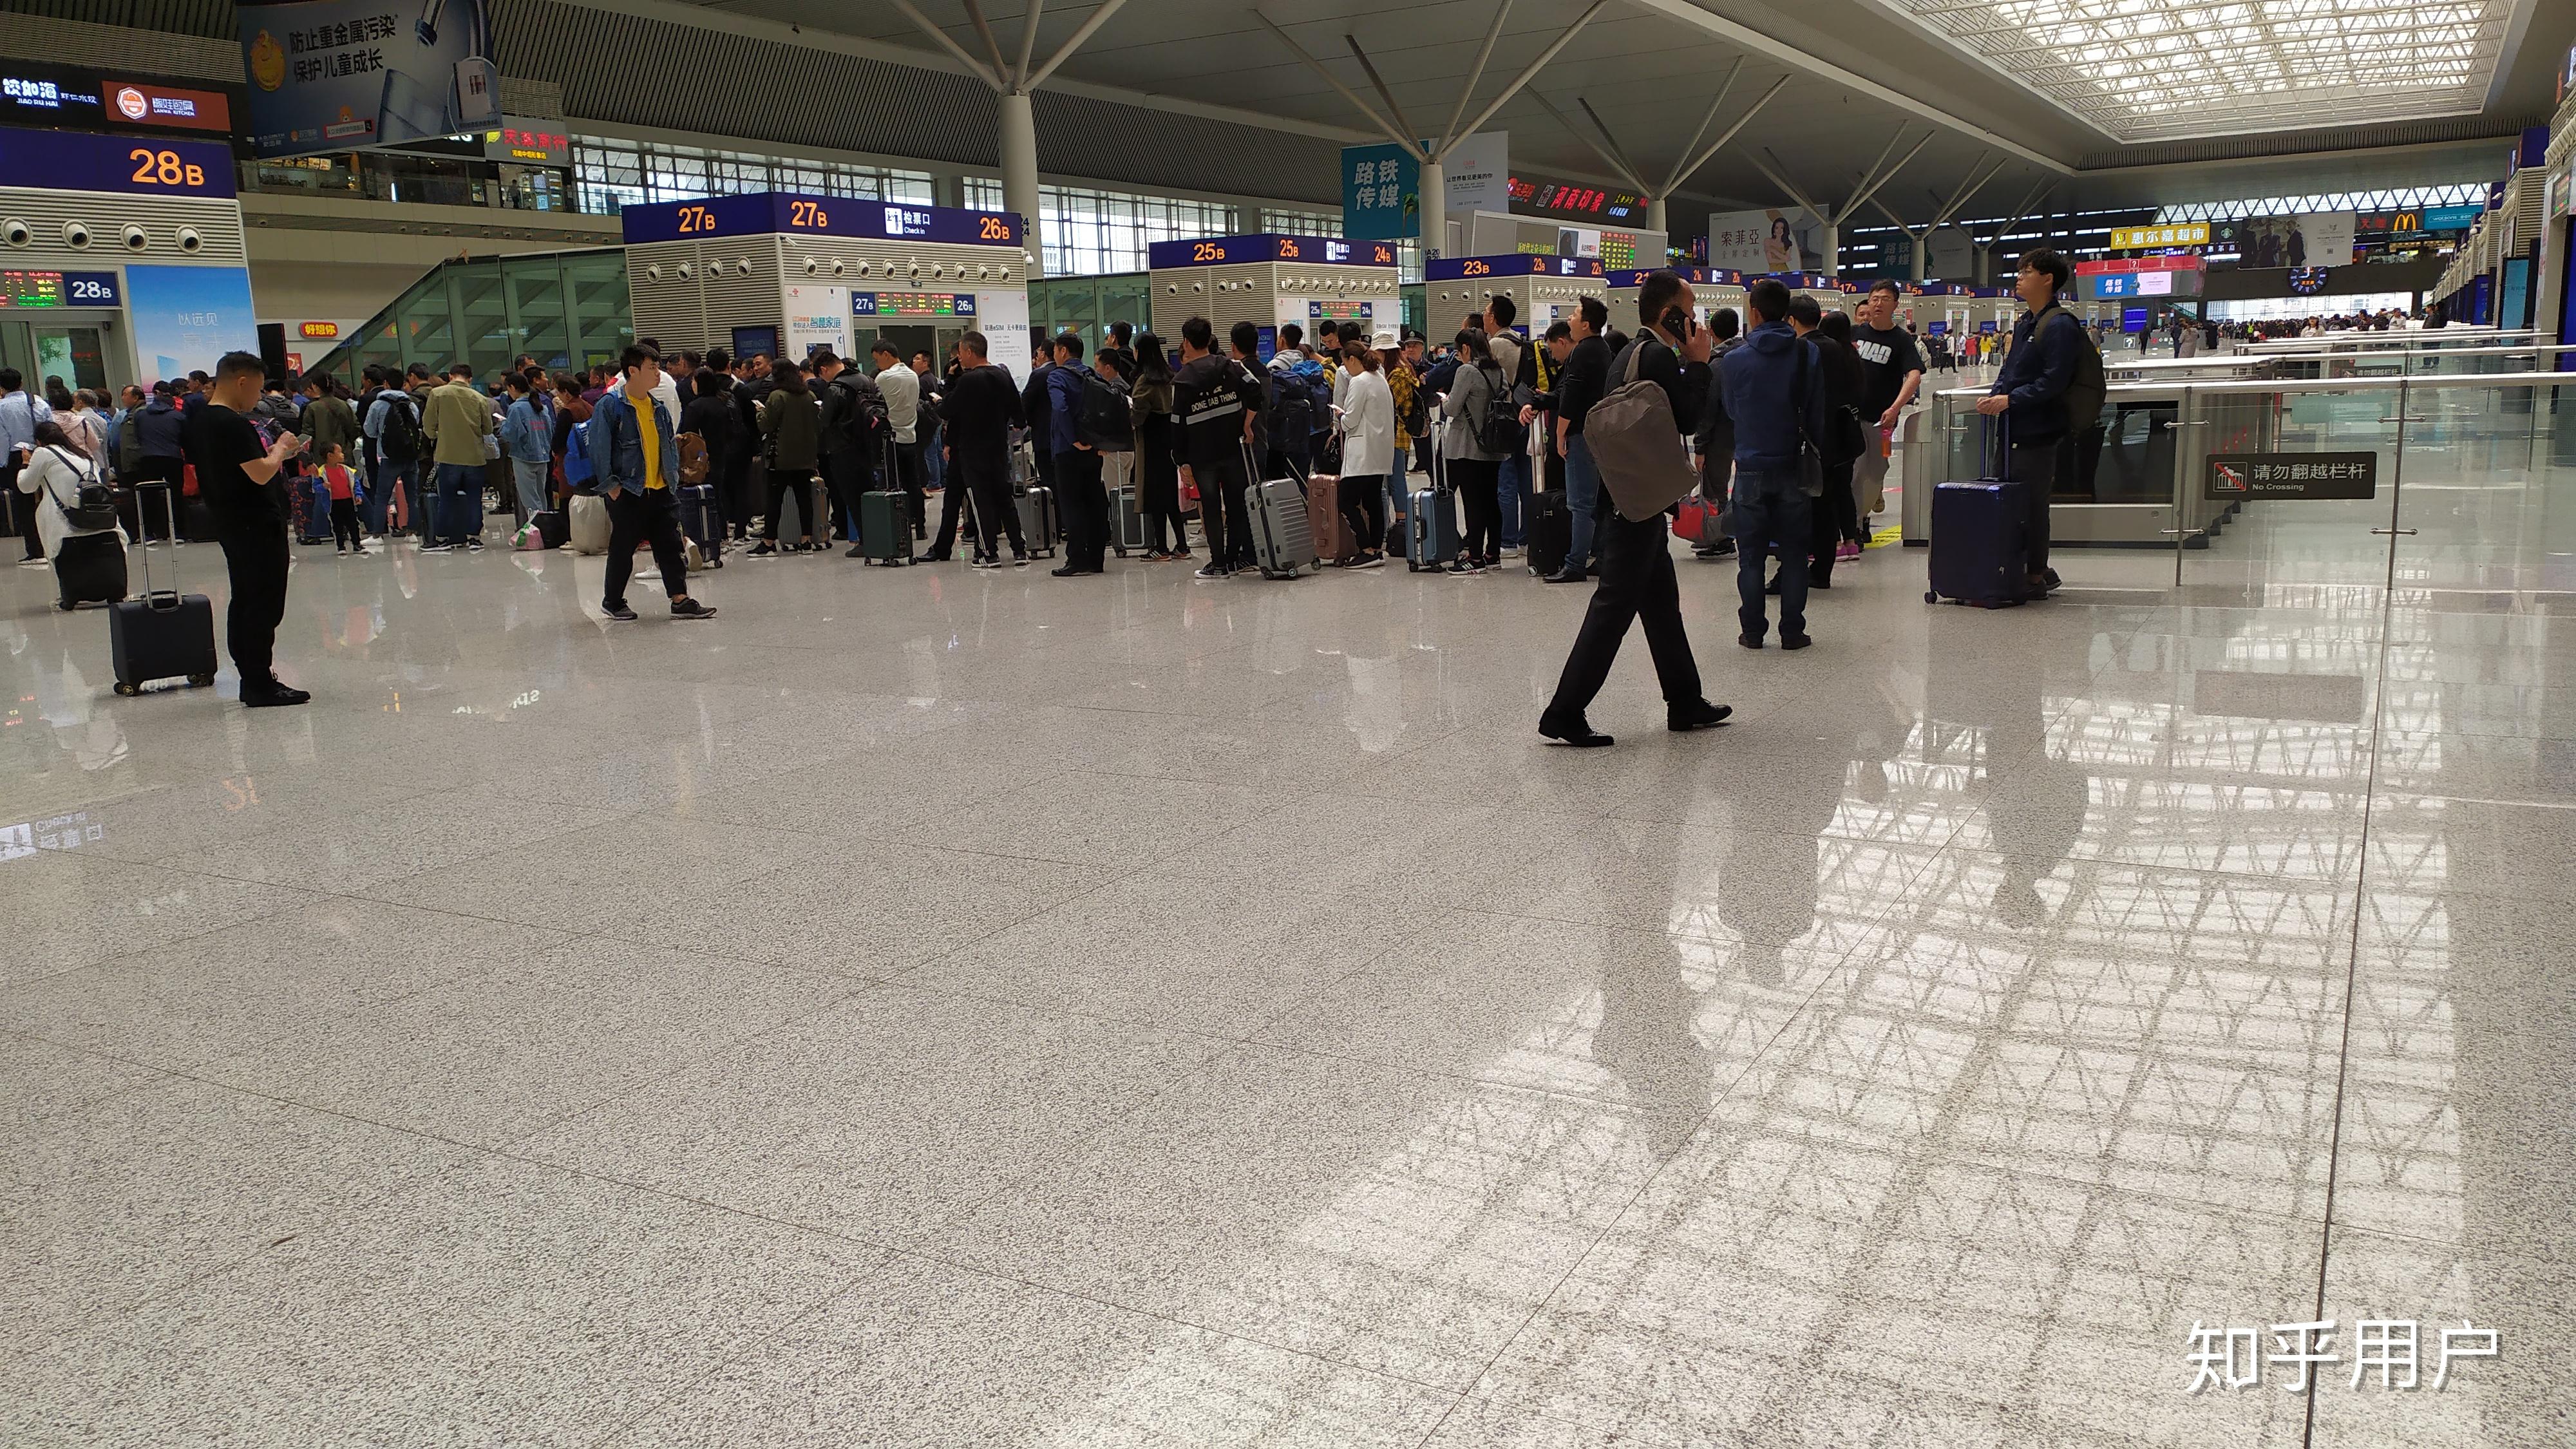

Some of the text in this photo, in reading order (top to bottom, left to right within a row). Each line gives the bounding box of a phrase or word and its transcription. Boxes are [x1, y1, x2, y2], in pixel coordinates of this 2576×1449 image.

[294, 48, 383, 83] 保护儿童成长
[129, 148, 204, 185] 28B
[1354, 159, 1399, 185] 路铁
[1356, 184, 1399, 211] 传媒
[1549, 185, 1605, 213] 河南印象
[678, 206, 715, 232] 27B
[791, 201, 828, 227] 27B
[904, 211, 931, 227] 检票口
[904, 227, 918, 235] Check
[980, 217, 1010, 240] 26B
[2132, 228, 2205, 245] 惠尔嘉超市
[1193, 243, 1225, 261] 25B
[1280, 240, 1299, 257] 25B
[1374, 246, 1391, 263] 24B
[1463, 261, 1490, 275] 23B
[1533, 258, 1546, 271] 23B
[72, 281, 112, 299] 28B
[855, 298, 873, 310] 27B
[957, 300, 973, 312] 26B
[178, 312, 218, 327] 以远见
[305, 324, 336, 336] 好想你
[1191, 400, 1208, 413] DONE
[1220, 392, 1237, 403] THING
[2253, 462, 2367, 480] 请勿翻越栏杆
